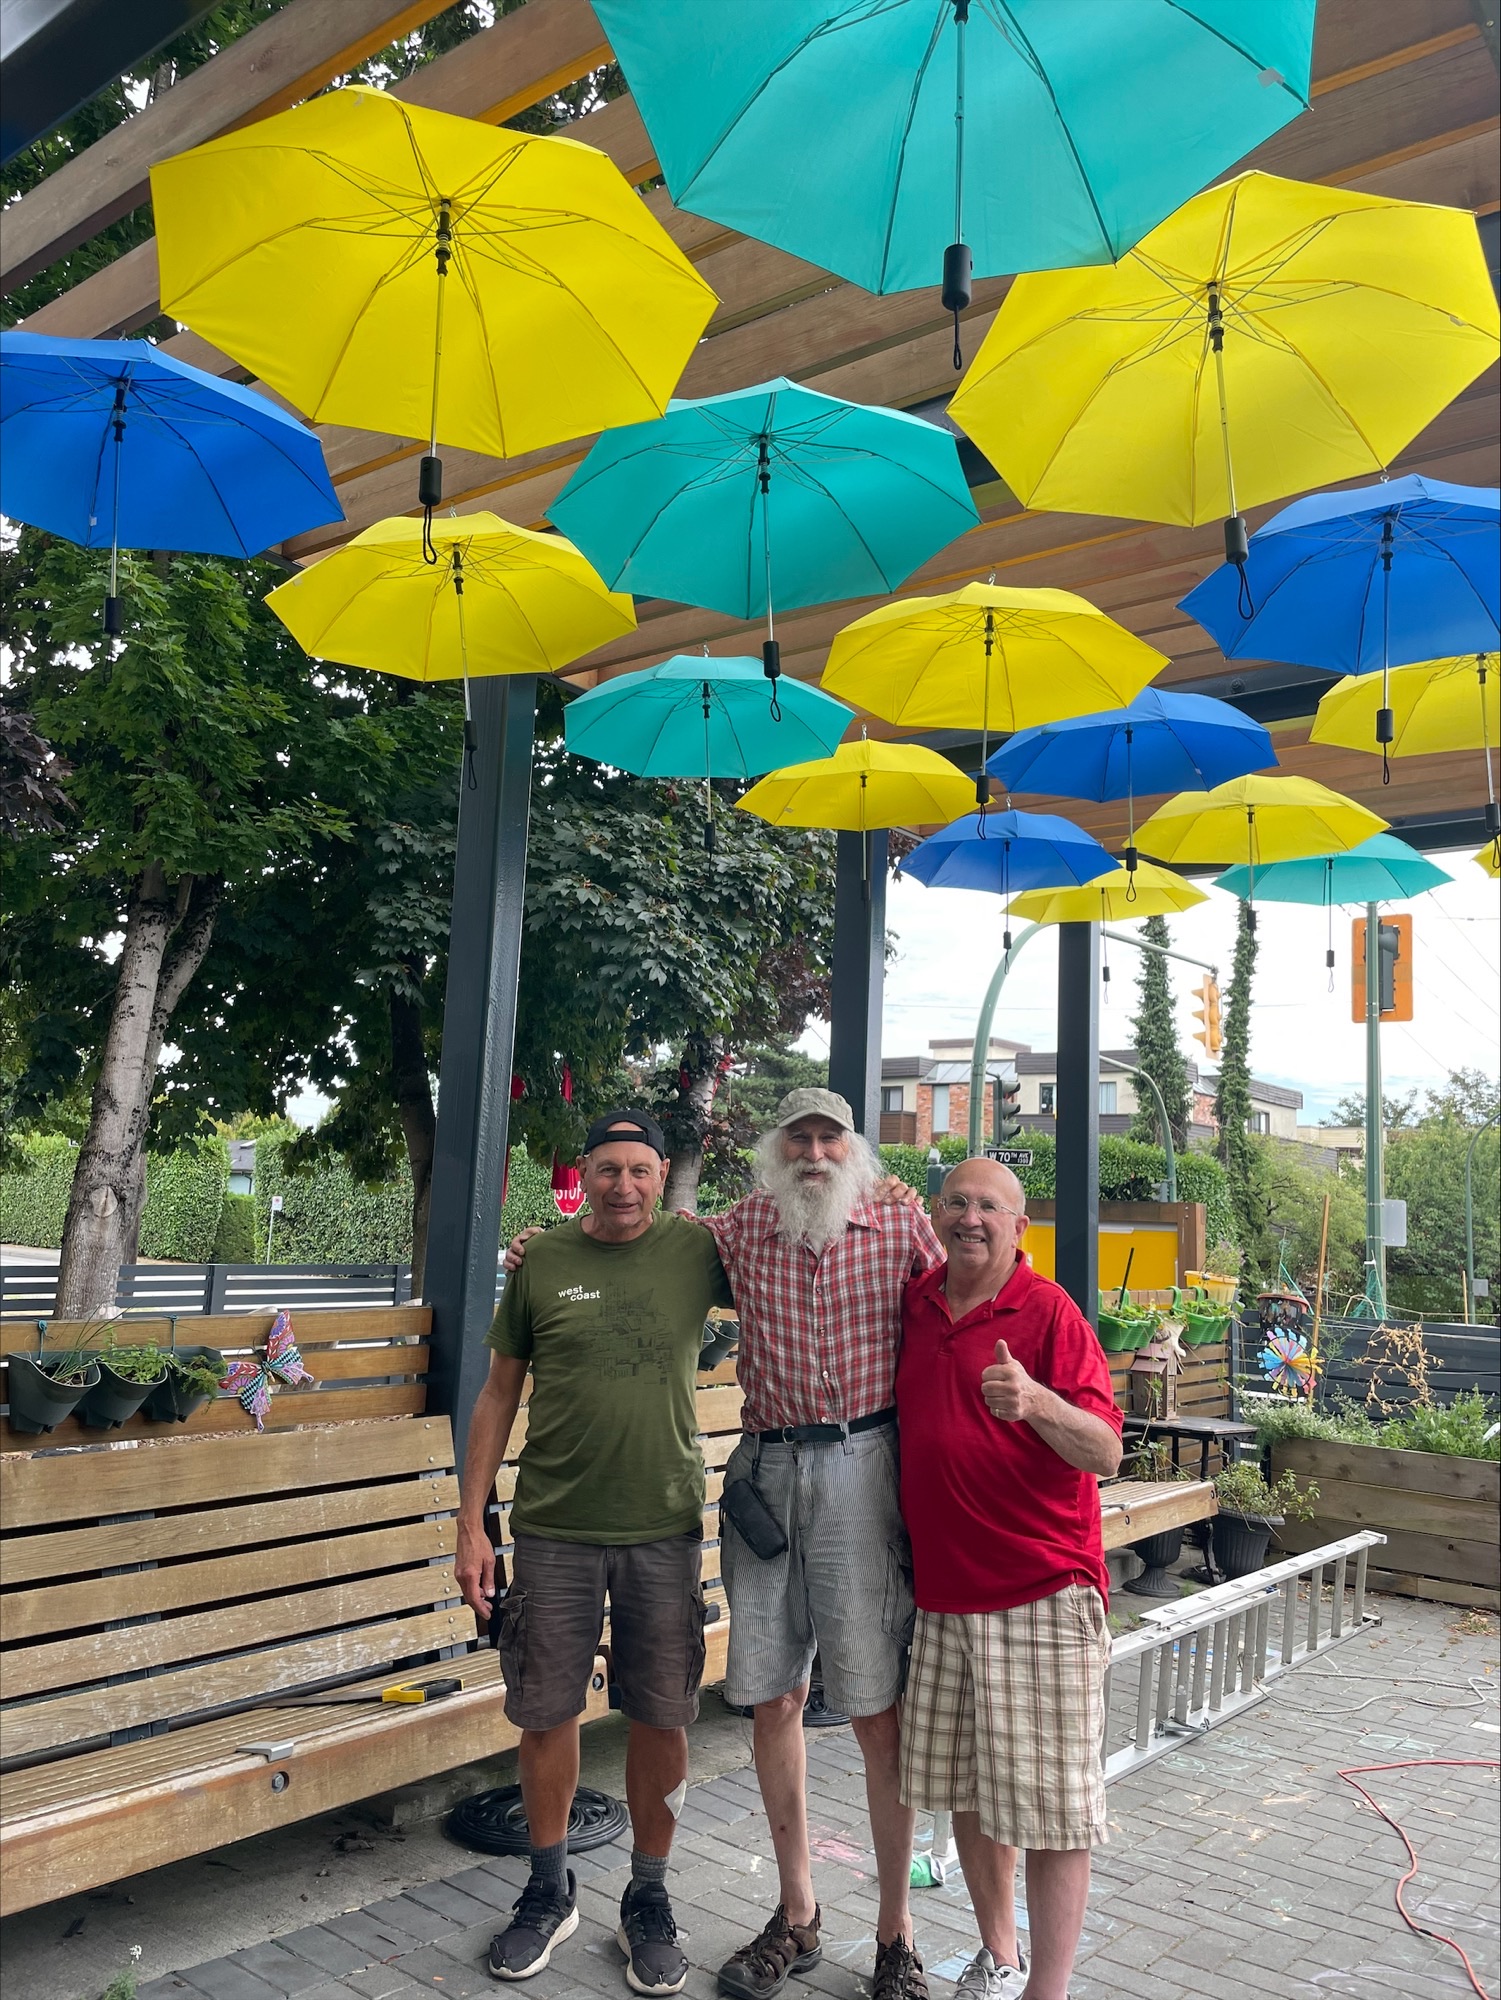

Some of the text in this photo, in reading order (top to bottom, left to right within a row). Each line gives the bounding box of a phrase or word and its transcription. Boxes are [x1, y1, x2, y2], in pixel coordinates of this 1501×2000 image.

[989, 1152, 997, 1160] W
[558, 1285, 583, 1298] west
[570, 1290, 600, 1301] coast
